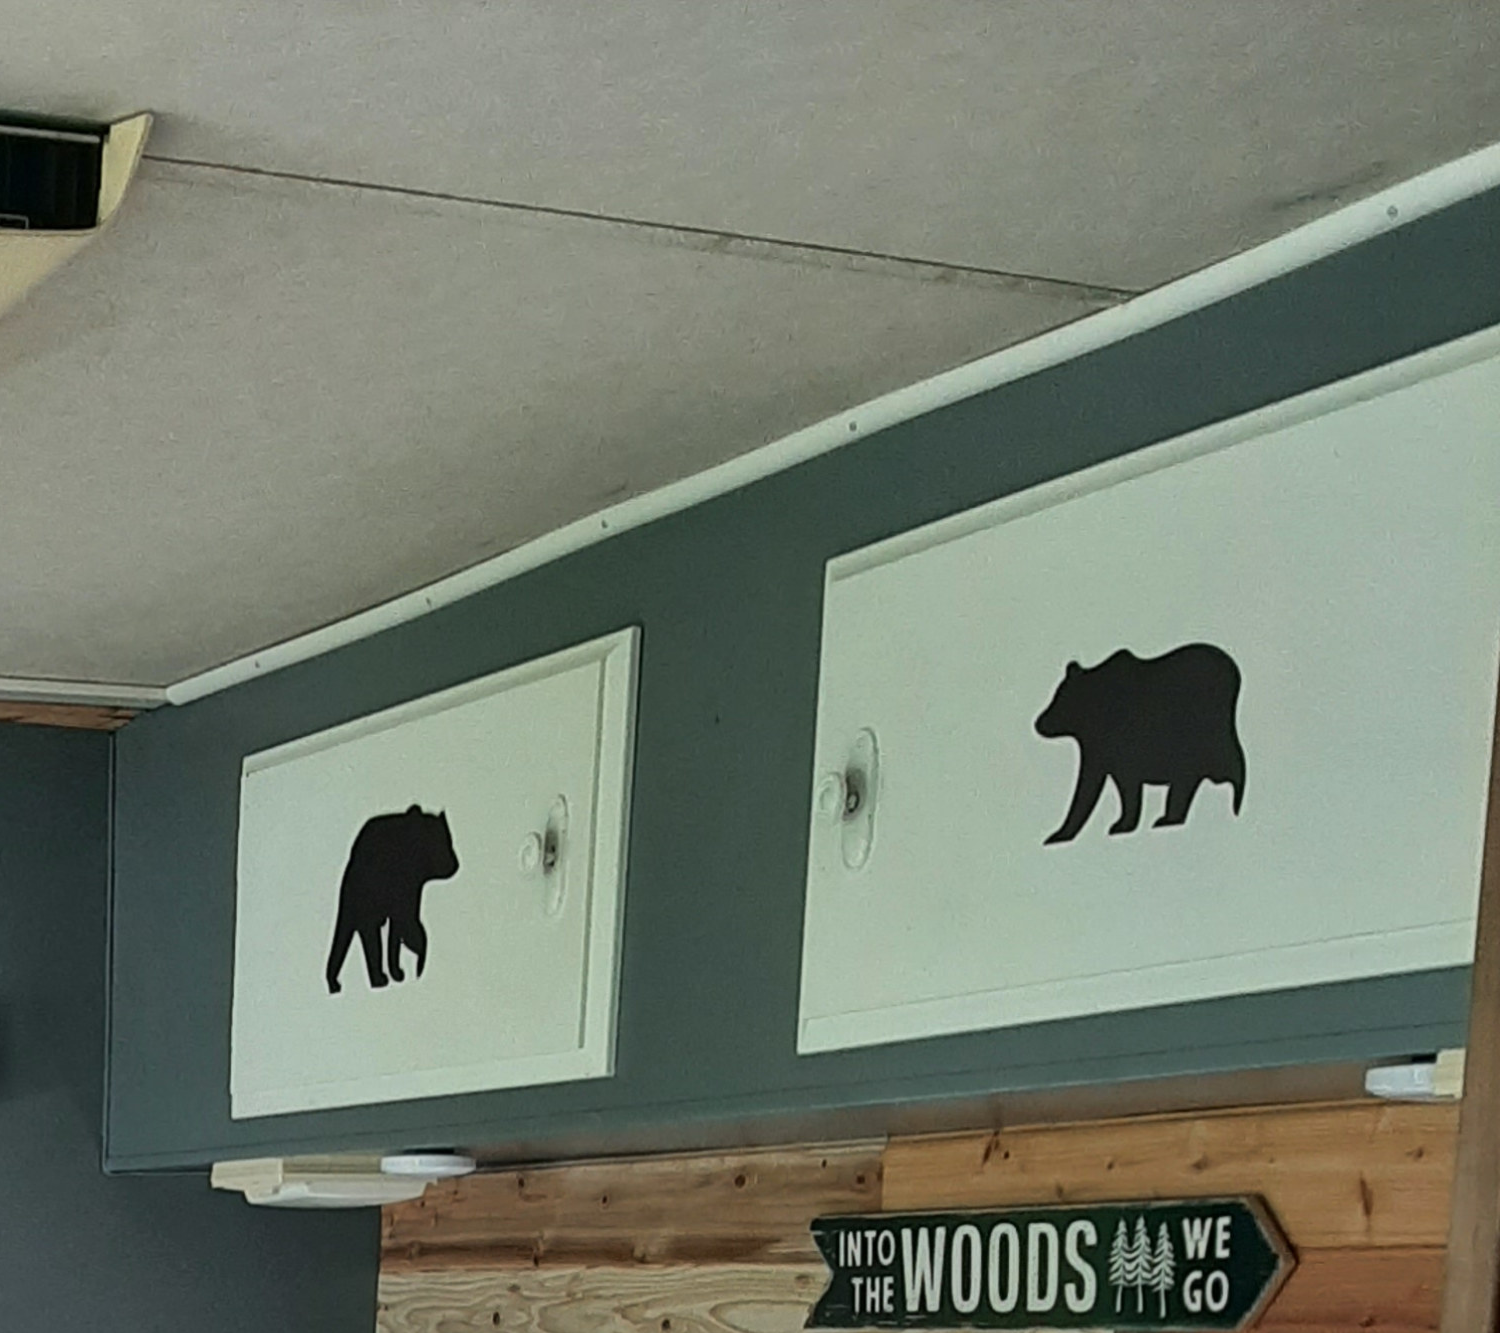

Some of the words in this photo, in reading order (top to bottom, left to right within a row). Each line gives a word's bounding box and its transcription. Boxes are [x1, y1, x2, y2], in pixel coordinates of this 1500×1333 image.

[838, 1229, 896, 1267] INTO
[1182, 1216, 1232, 1260] WE
[901, 1220, 1098, 1313] WOODS
[852, 1276, 894, 1313] THE
[1183, 1271, 1230, 1313] GO
